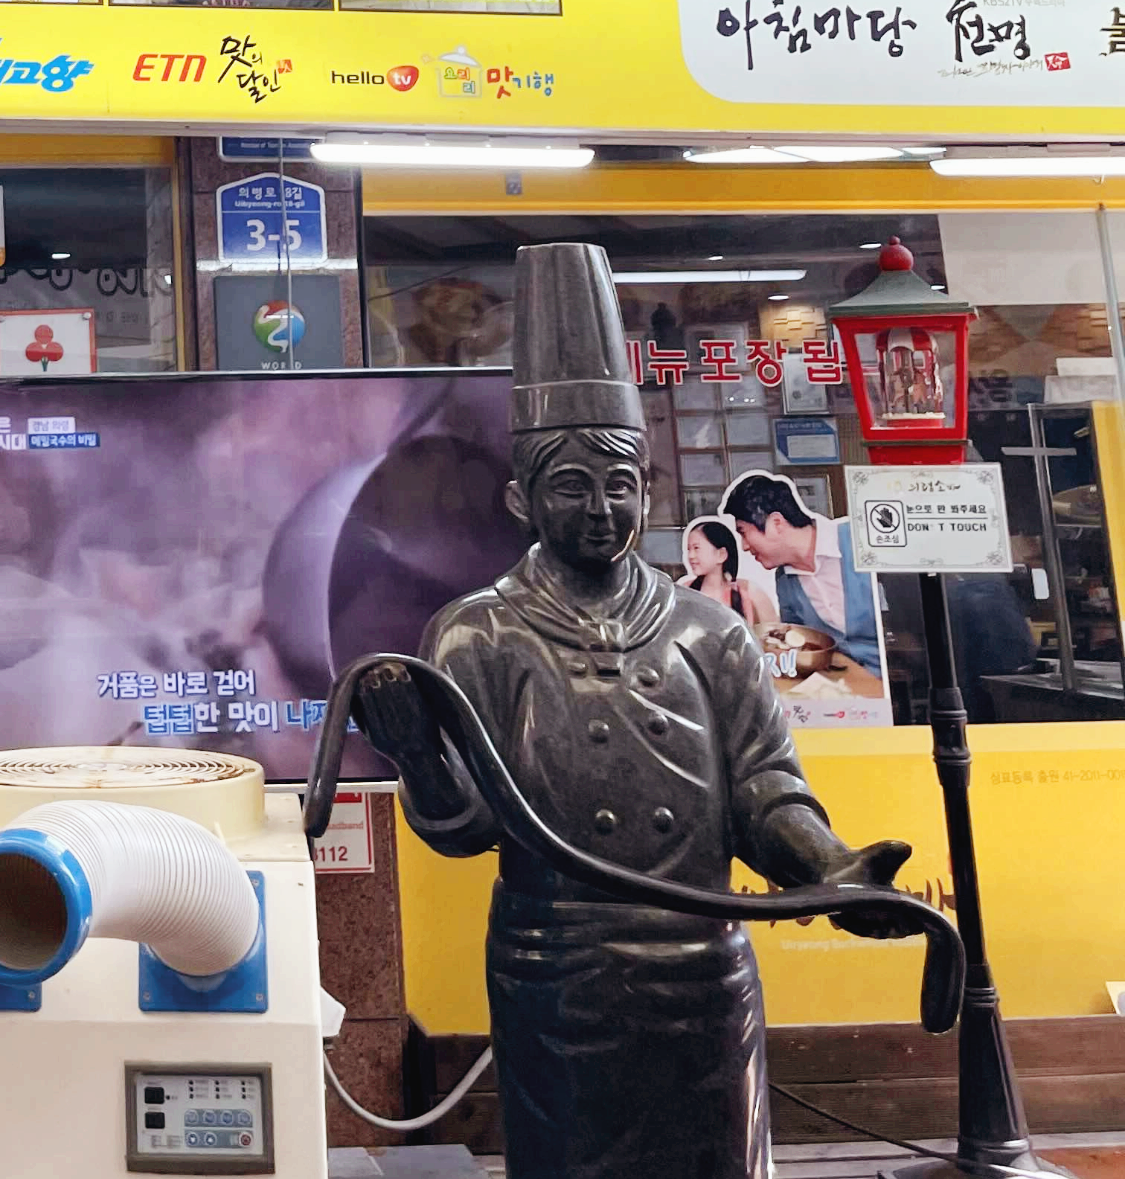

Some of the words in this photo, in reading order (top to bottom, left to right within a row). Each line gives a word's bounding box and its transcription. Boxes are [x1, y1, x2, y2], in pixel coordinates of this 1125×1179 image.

[132, 53, 207, 83] ETN
[331, 70, 385, 86] hello
[392, 72, 412, 86] tv
[245, 219, 303, 251] 3-5
[261, 360, 303, 370] WORD
[77, 433, 97, 447] 비밀
[950, 523, 988, 532] TOUCH
[875, 534, 900, 544] 손조심
[96, 672, 158, 699] 거품은
[164, 671, 208, 696] 바로
[213, 669, 256, 695] 걷어
[142, 701, 221, 735] 텁텁한
[228, 701, 279, 733] 맛이
